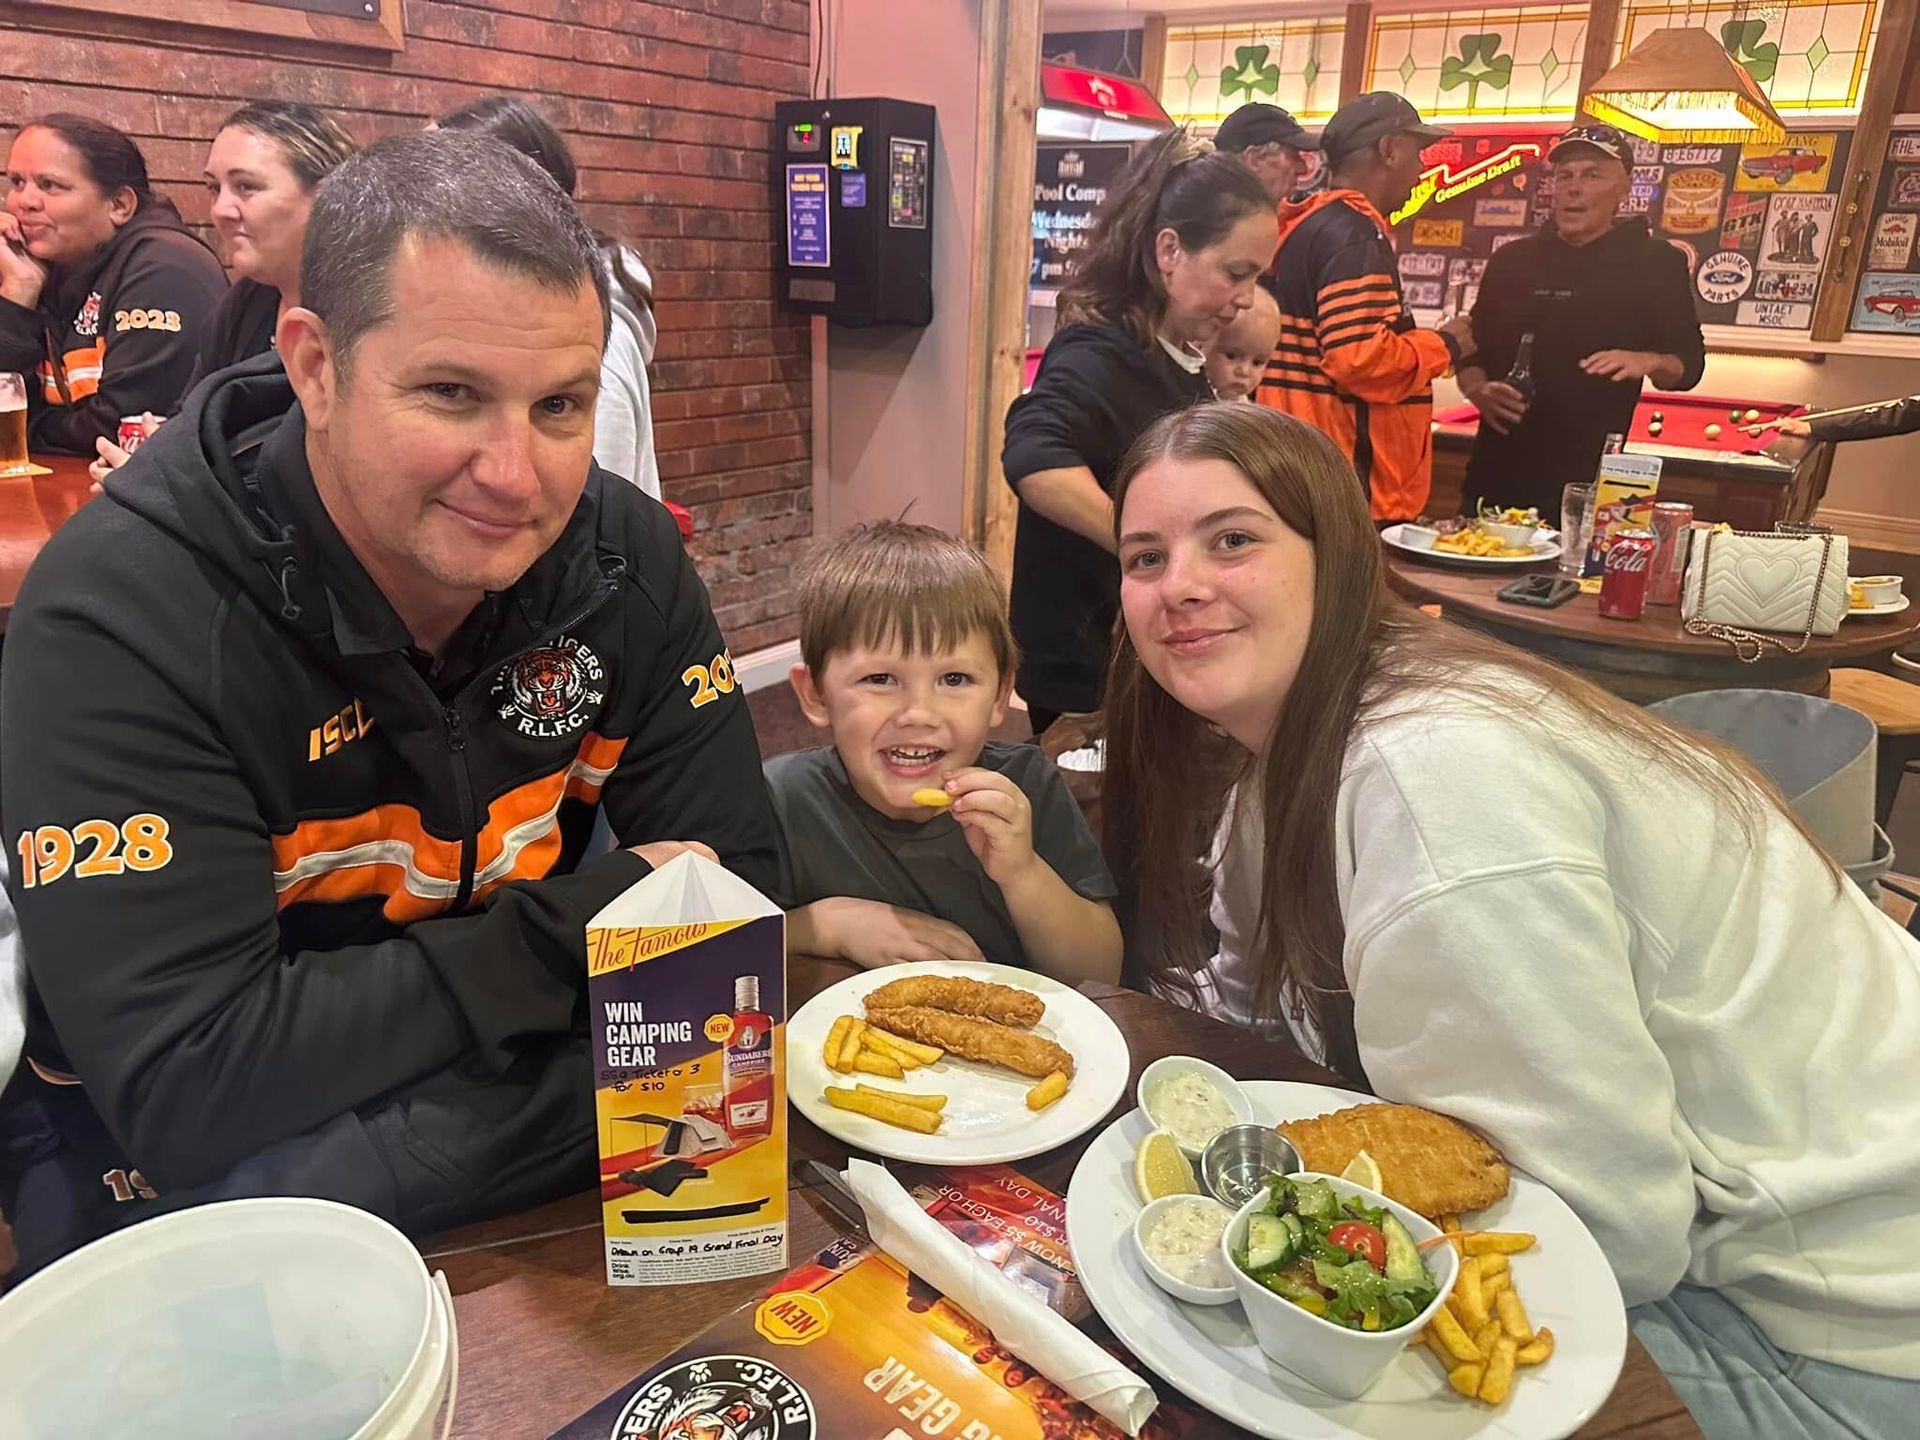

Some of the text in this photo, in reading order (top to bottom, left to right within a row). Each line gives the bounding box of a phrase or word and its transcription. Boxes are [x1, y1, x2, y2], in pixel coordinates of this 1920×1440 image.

[1487, 154, 1521, 181] Draft
[1034, 183, 1107, 205] Pool Comp
[1723, 211, 1764, 233] GTX
[1041, 262, 1062, 281] pm
[1705, 252, 1750, 271] GENUINE
[1703, 287, 1740, 301] PARTS
[114, 308, 182, 333] 2023
[1759, 314, 1785, 326] MSOC
[549, 635, 603, 681] IGERS
[17, 812, 174, 889] 1928
[587, 922, 708, 972] The Famous
[604, 1001, 643, 1023] WIN
[606, 1020, 693, 1046] CAMPING
[710, 1022, 730, 1034] NEW
[607, 1045, 657, 1067] GEAR
[632, 1068, 671, 1080] Ticket
[689, 1063, 701, 1075] 3
[611, 1080, 634, 1093] for
[937, 1184, 963, 1204] OR
[993, 1176, 1033, 1199] DAY
[961, 1200, 1012, 1232] EACH
[641, 1249, 654, 1257] on
[703, 1240, 732, 1252] Grand
[735, 1237, 759, 1250] Final
[762, 1233, 784, 1247] Day
[1023, 1237, 1071, 1270] NOW
[769, 1299, 820, 1335] NEW
[734, 1360, 809, 1424] R.L.F.C.
[862, 1356, 963, 1437] GEAR
